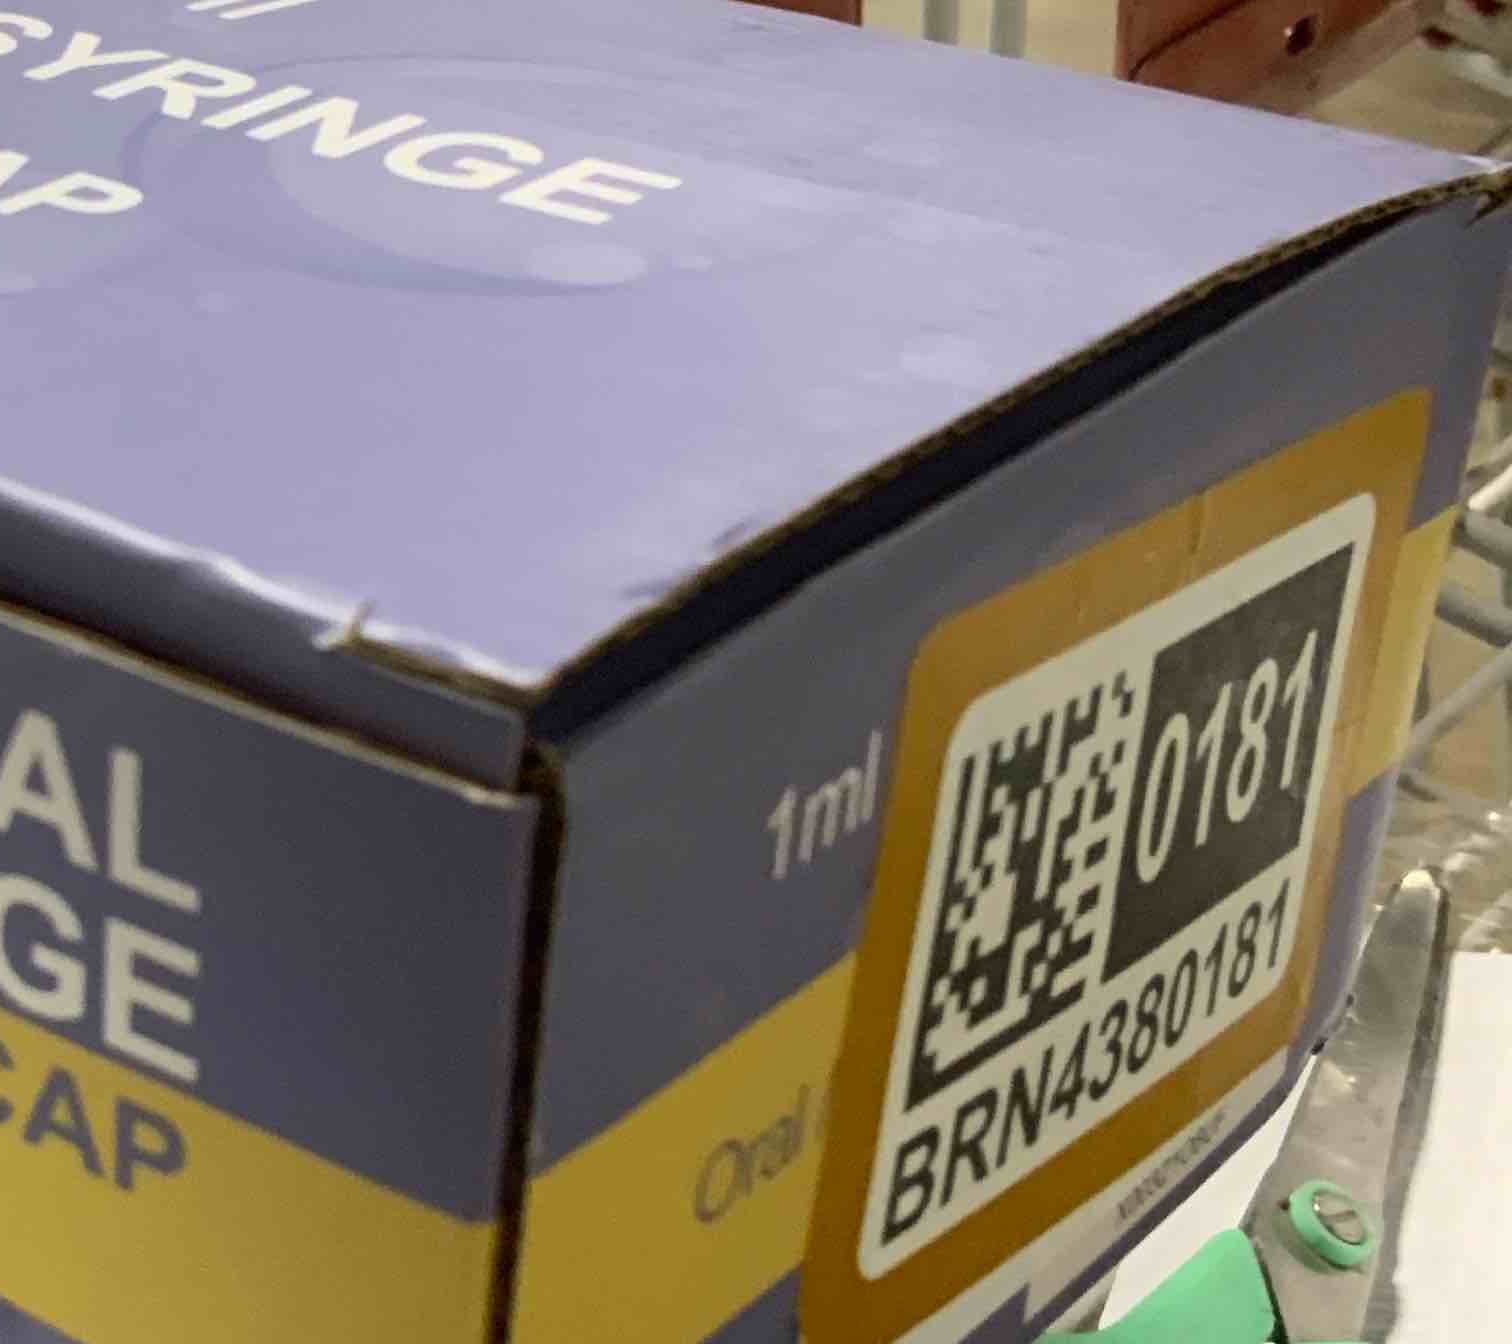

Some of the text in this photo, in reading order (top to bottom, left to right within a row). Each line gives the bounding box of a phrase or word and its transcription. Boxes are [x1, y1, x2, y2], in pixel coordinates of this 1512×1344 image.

[766, 728, 883, 880] 1ml
[1137, 628, 1320, 883] 0181
[694, 1083, 810, 1224] Oral
[881, 877, 1290, 1247] BRN4380181
